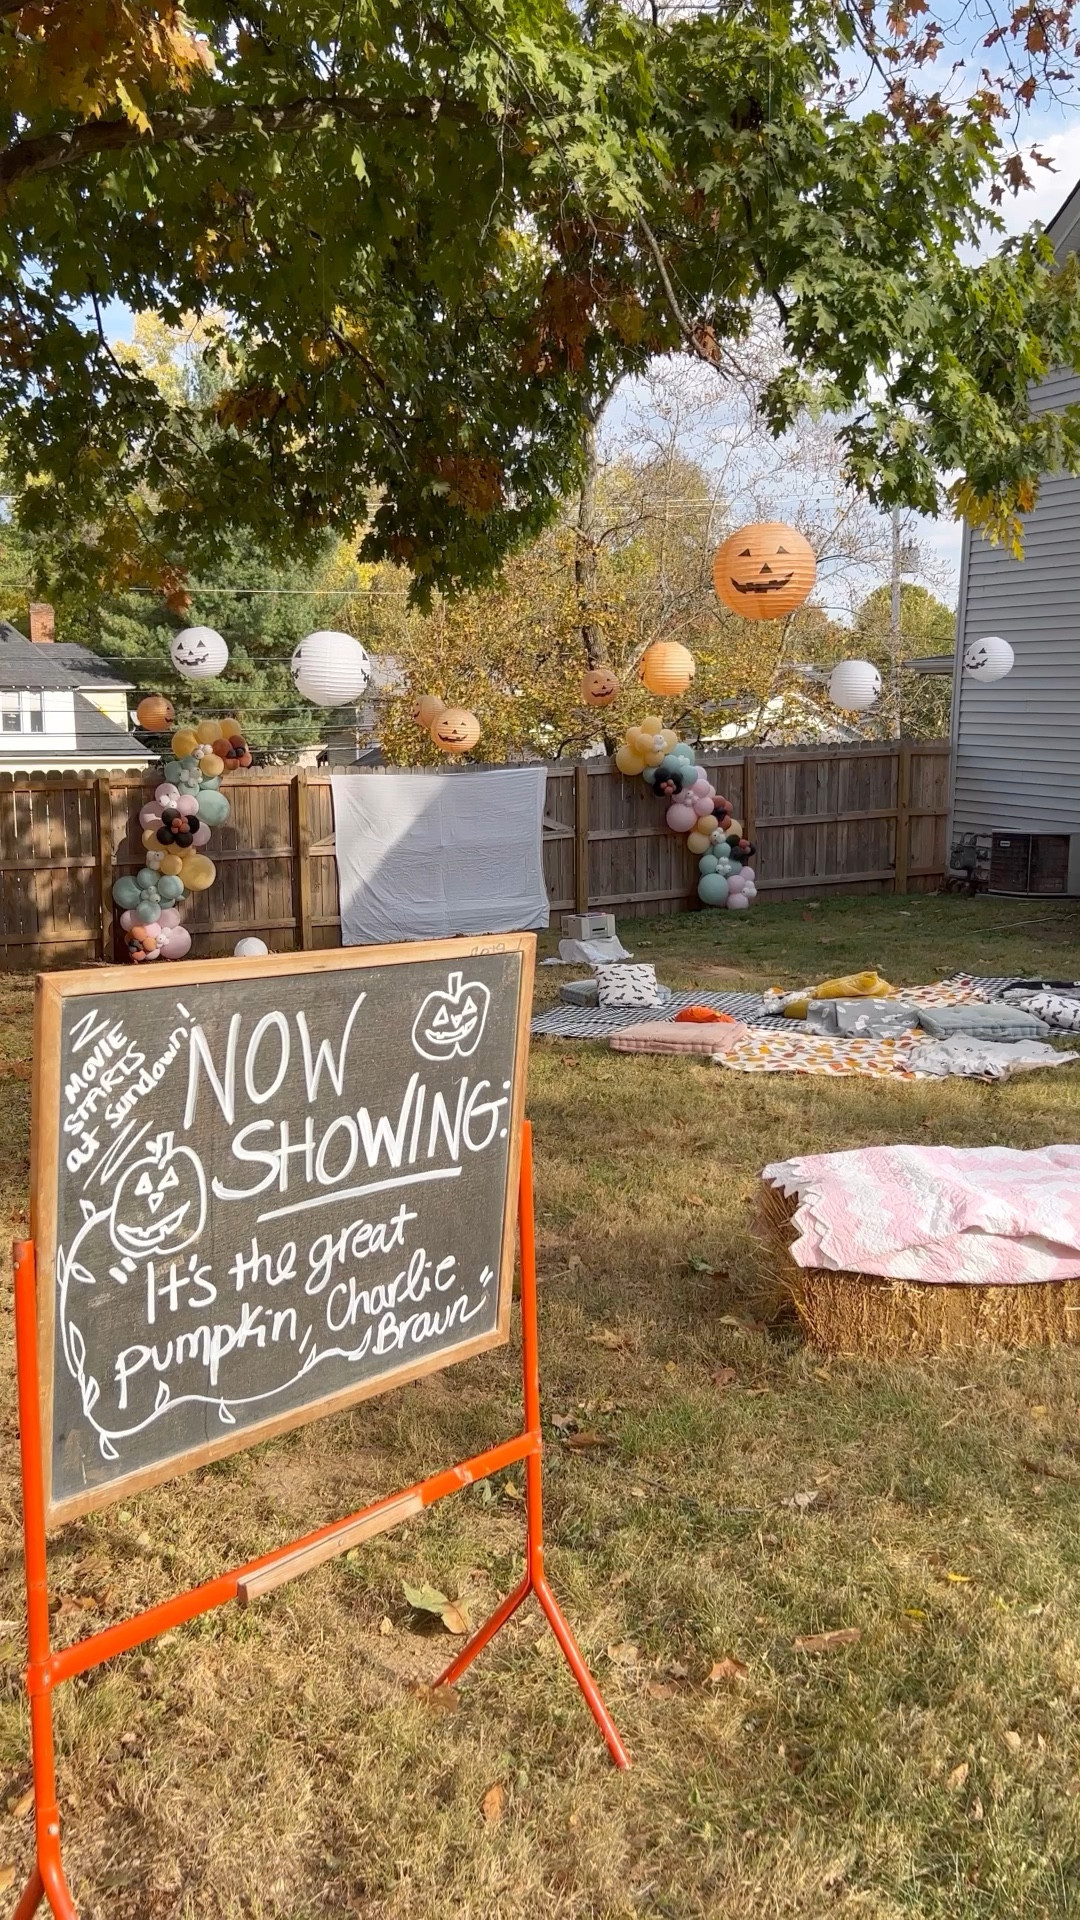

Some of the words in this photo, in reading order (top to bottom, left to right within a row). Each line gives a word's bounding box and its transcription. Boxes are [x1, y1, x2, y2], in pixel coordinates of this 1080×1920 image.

[63, 1040, 146, 1136] STARTS
[65, 1020, 127, 1104] MOVIE
[66, 1125, 100, 1173] at
[105, 1002, 196, 1129] sundown!
[183, 991, 367, 1130] NOW
[211, 1071, 511, 1200] SHOWING:
[228, 1237, 297, 1292] the
[305, 1204, 418, 1295] great
[326, 1247, 456, 1331] Charlie
